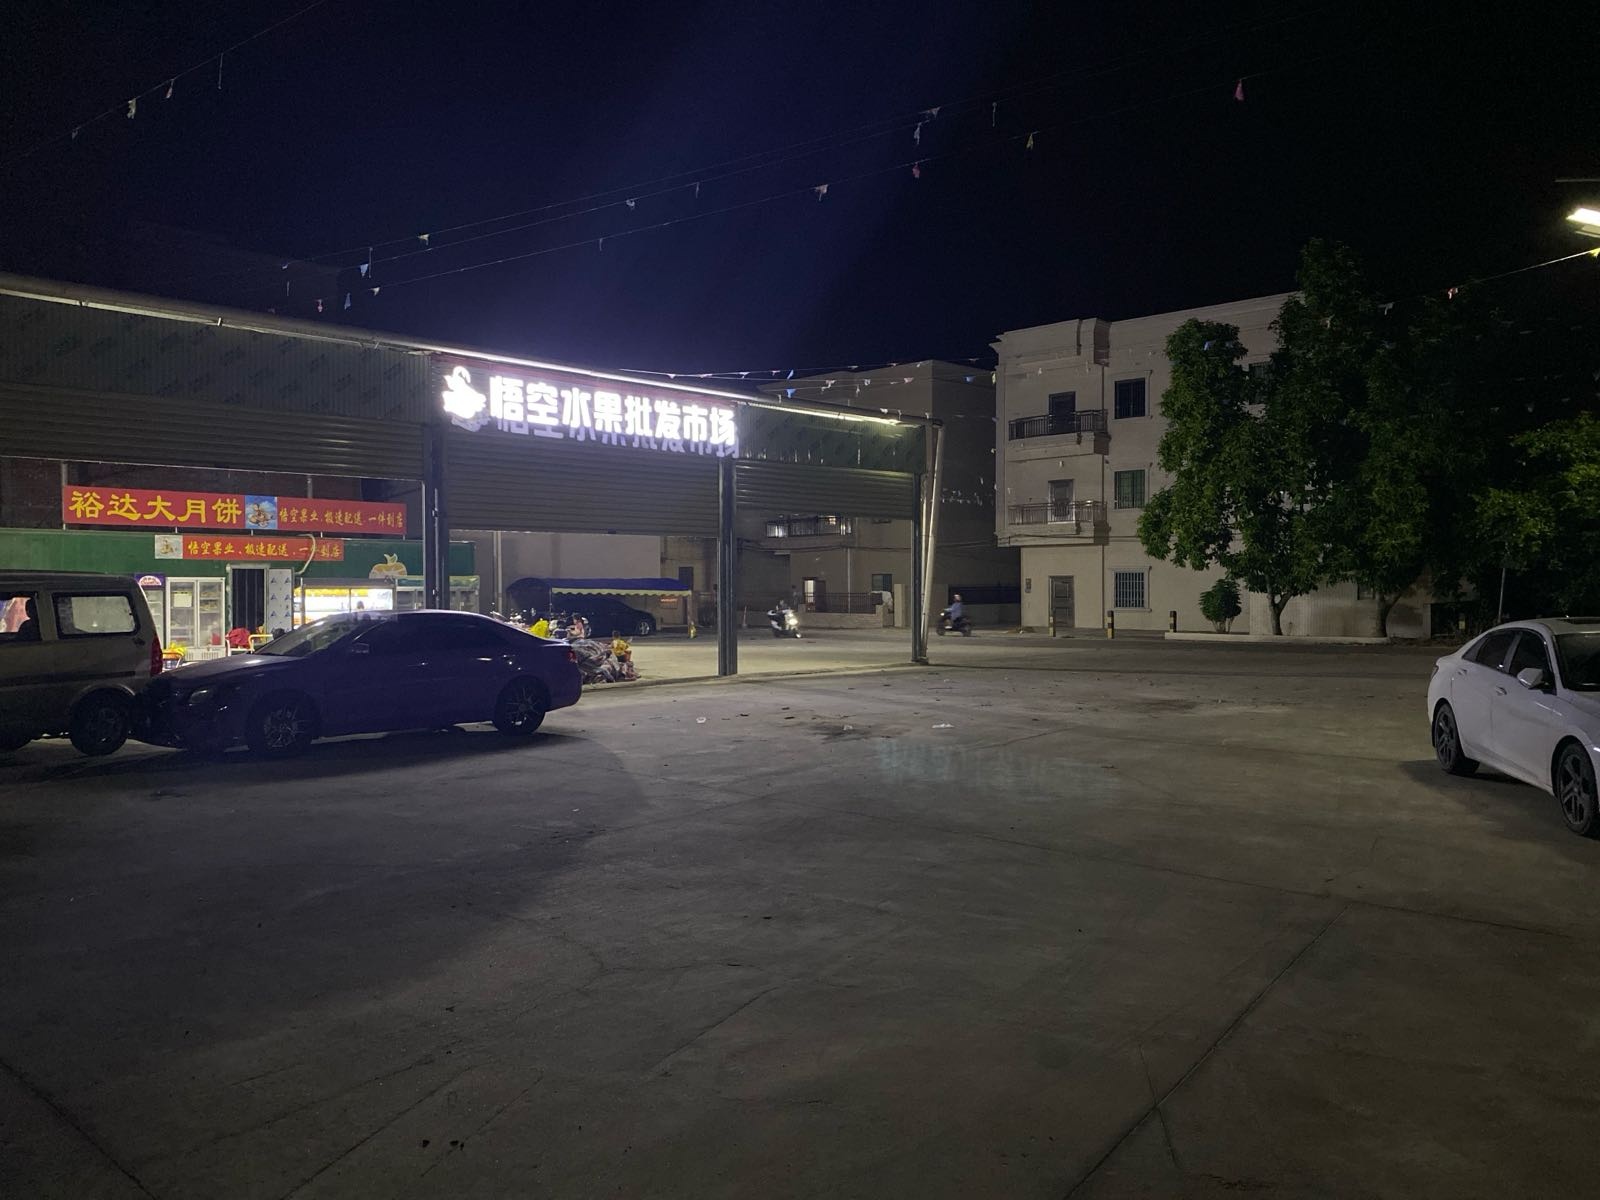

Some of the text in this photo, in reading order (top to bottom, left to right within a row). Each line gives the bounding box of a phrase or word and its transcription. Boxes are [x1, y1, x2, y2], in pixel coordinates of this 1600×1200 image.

[489, 375, 736, 446] 悟空水果批发市场
[69, 491, 242, 524] 裕达大月饼
